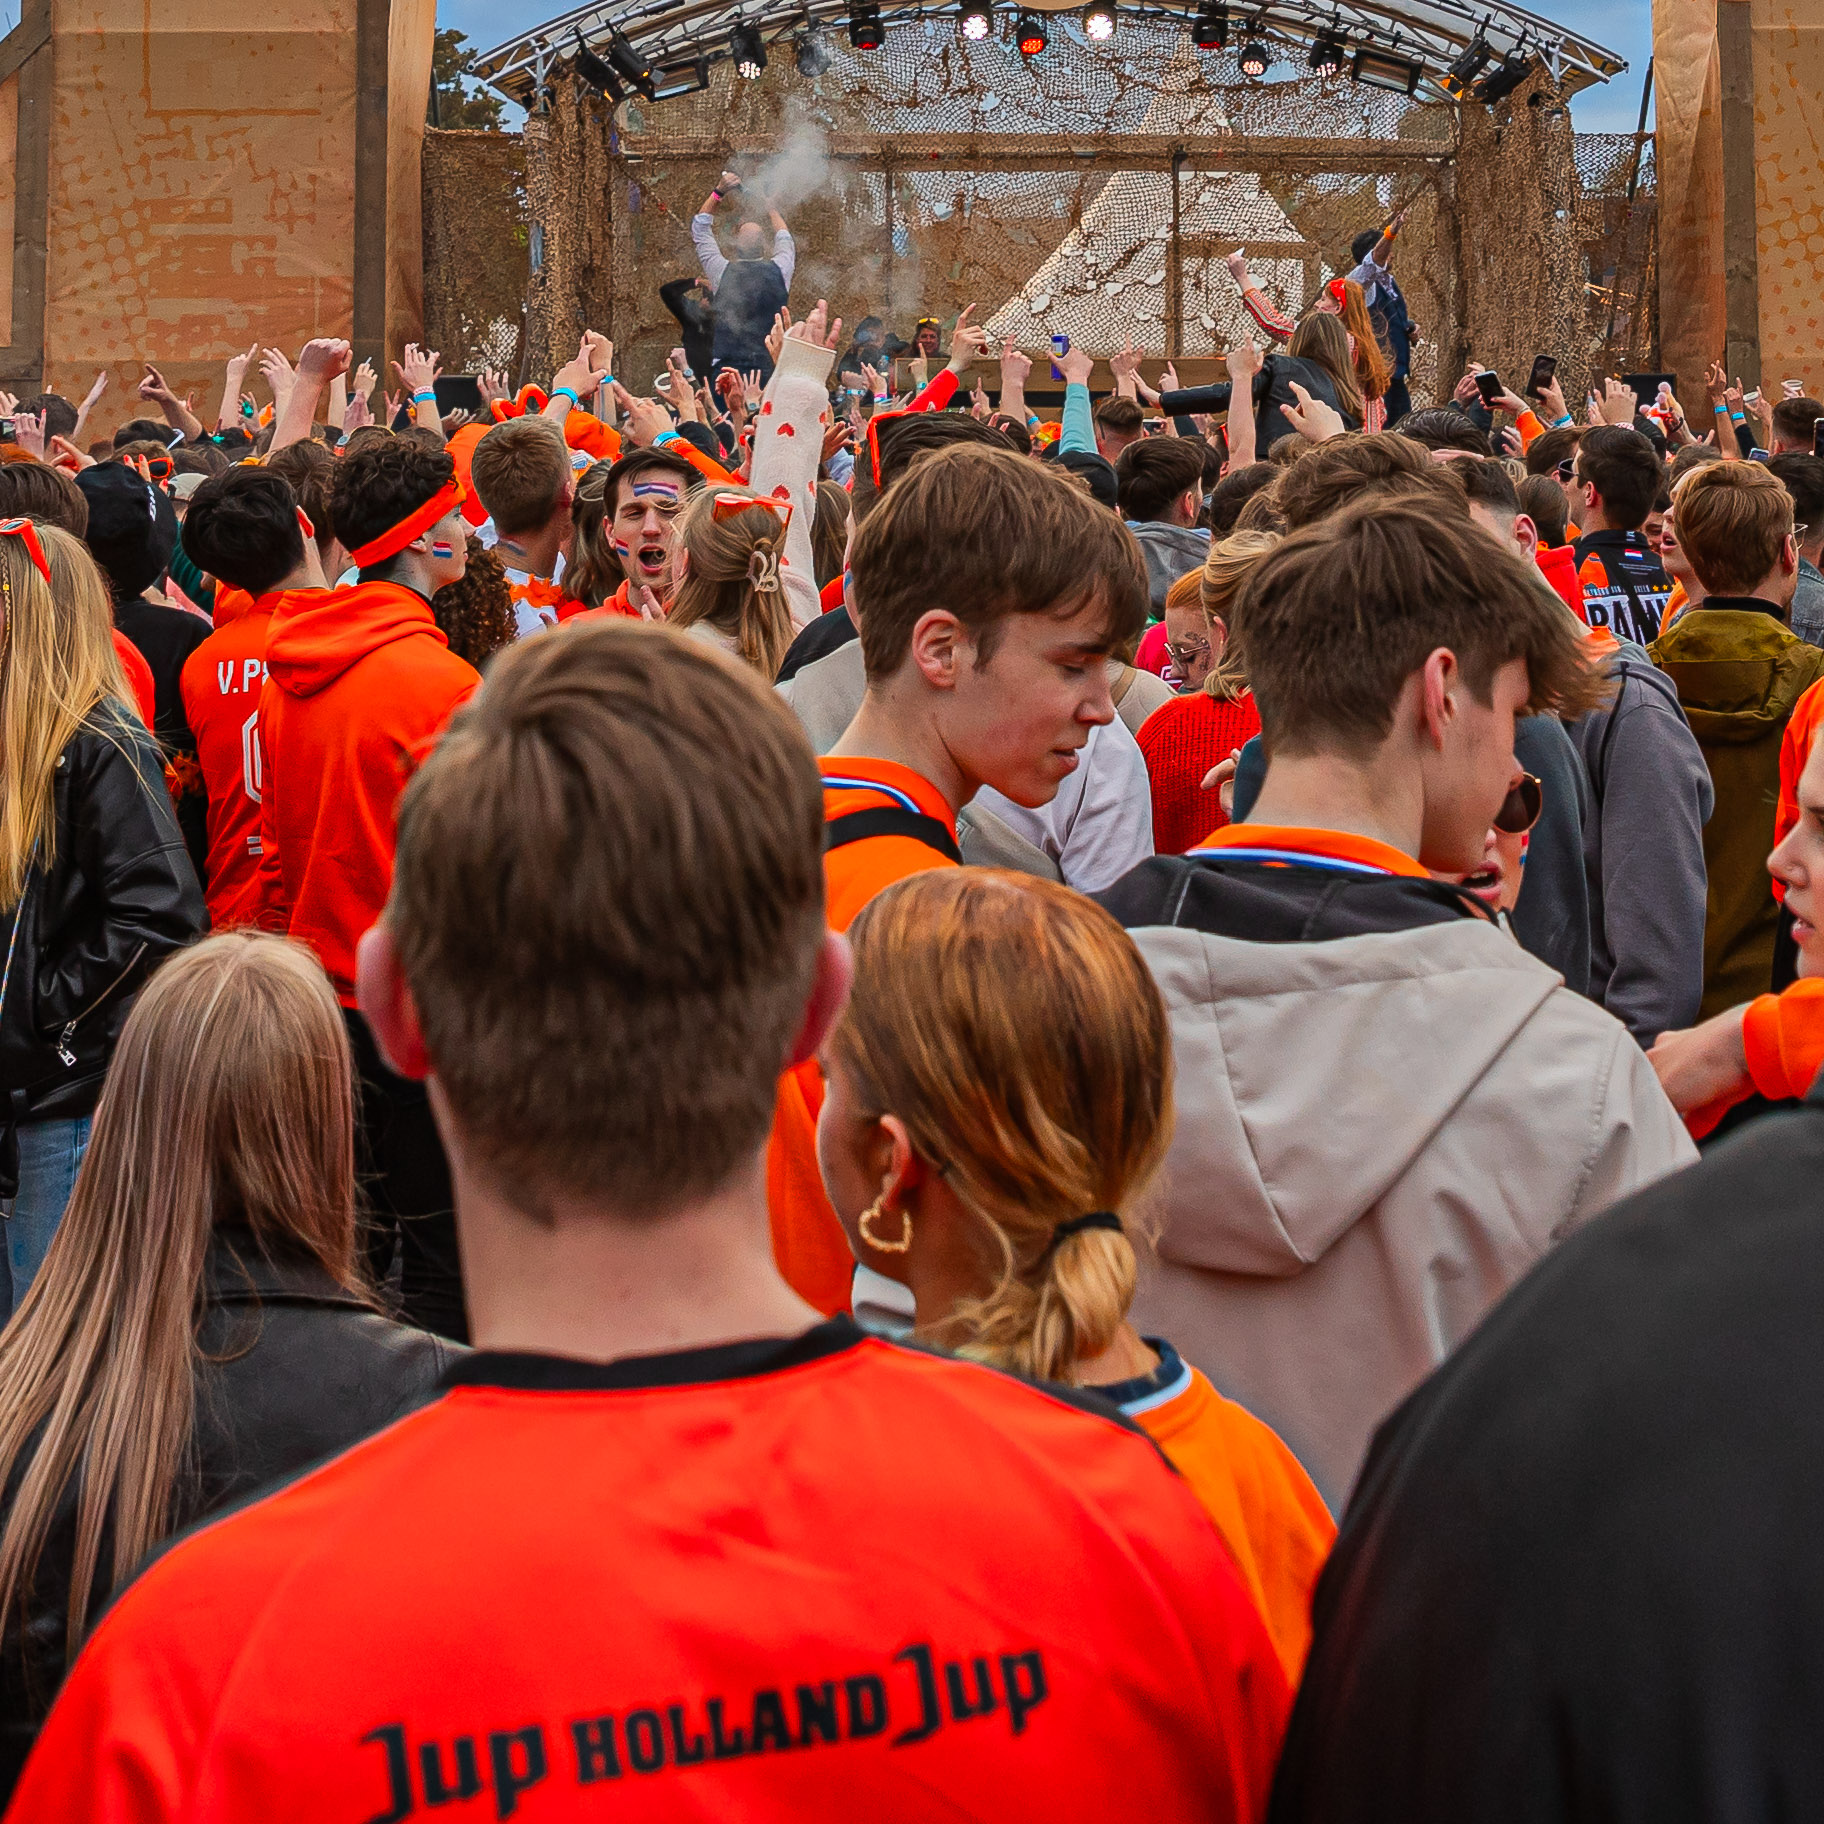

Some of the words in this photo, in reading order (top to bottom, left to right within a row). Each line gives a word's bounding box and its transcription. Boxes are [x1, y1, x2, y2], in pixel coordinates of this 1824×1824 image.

[360, 1723, 548, 1824] Jup
[570, 1673, 889, 1785] HOLLAND
[891, 1642, 1050, 1749] Jup
